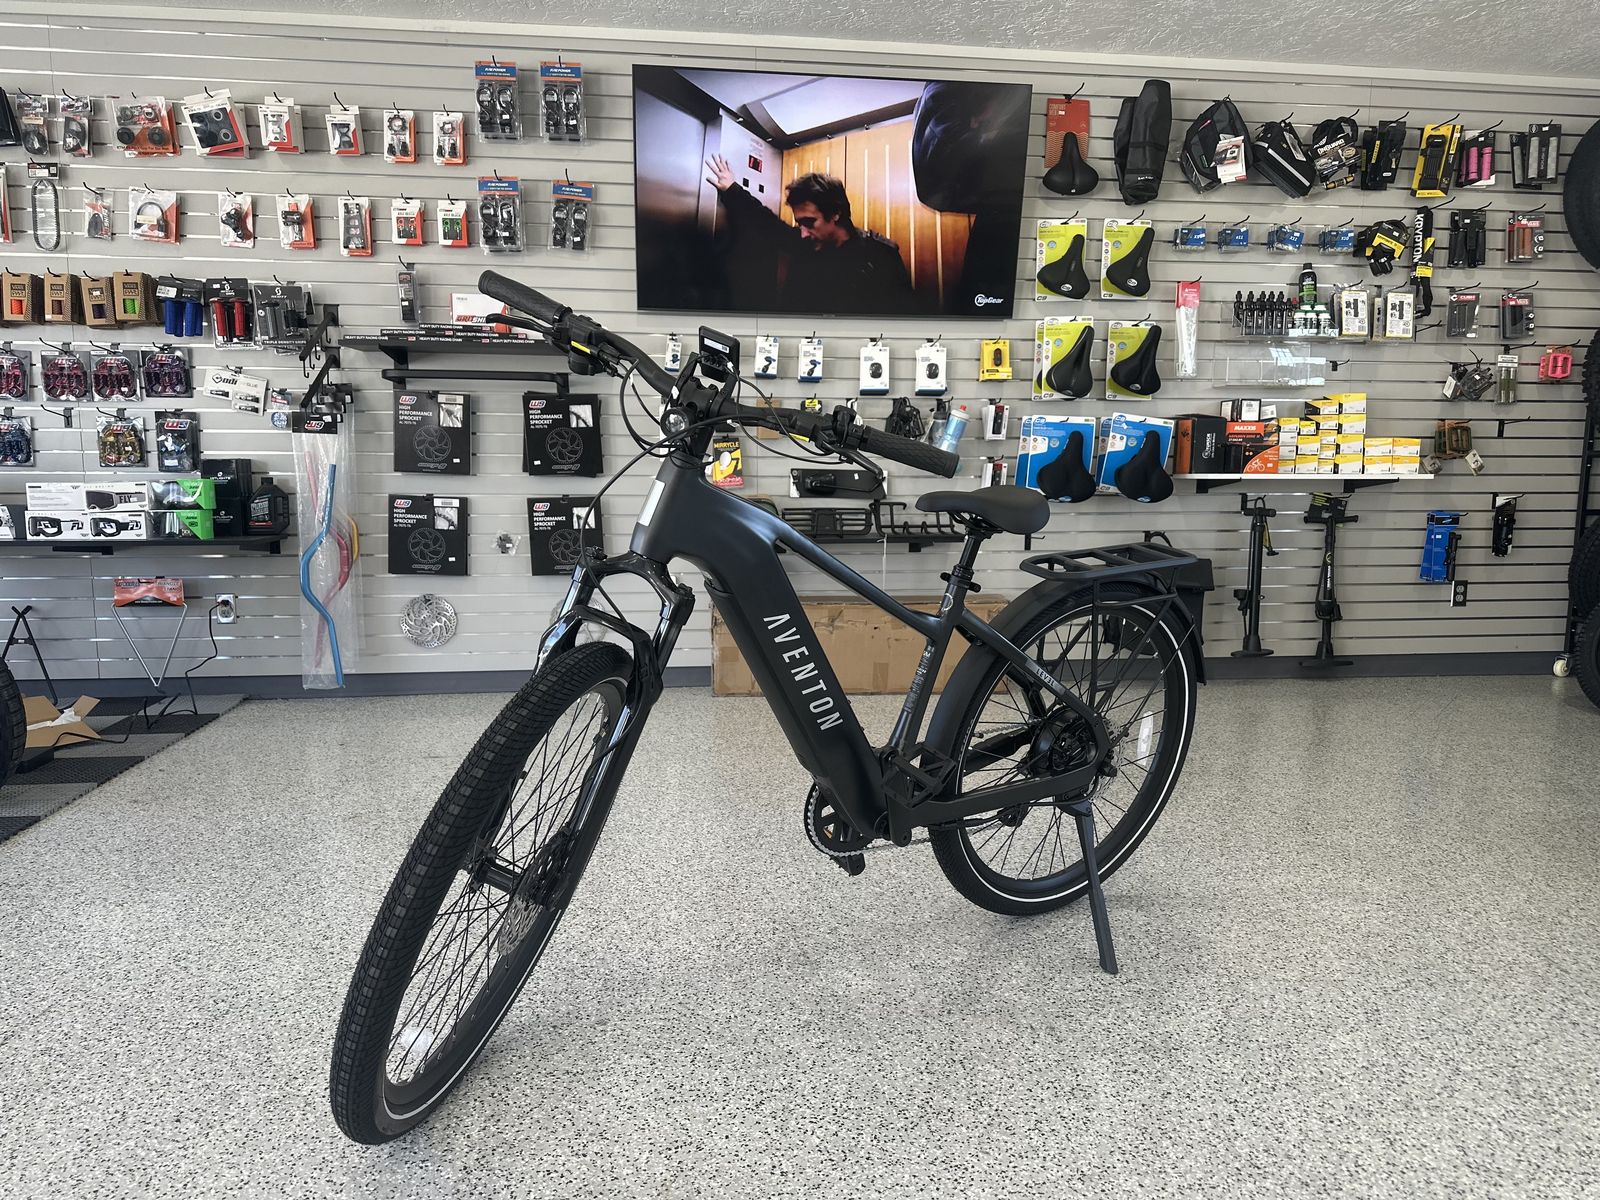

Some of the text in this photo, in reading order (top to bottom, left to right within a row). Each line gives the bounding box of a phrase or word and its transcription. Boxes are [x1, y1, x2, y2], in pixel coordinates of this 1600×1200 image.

[1317, 139, 1345, 155] ONGUARD
[975, 295, 1004, 305] TopGear
[456, 315, 486, 323] GRITSHI
[119, 495, 132, 503] FLY
[763, 614, 843, 730] AVENTON
